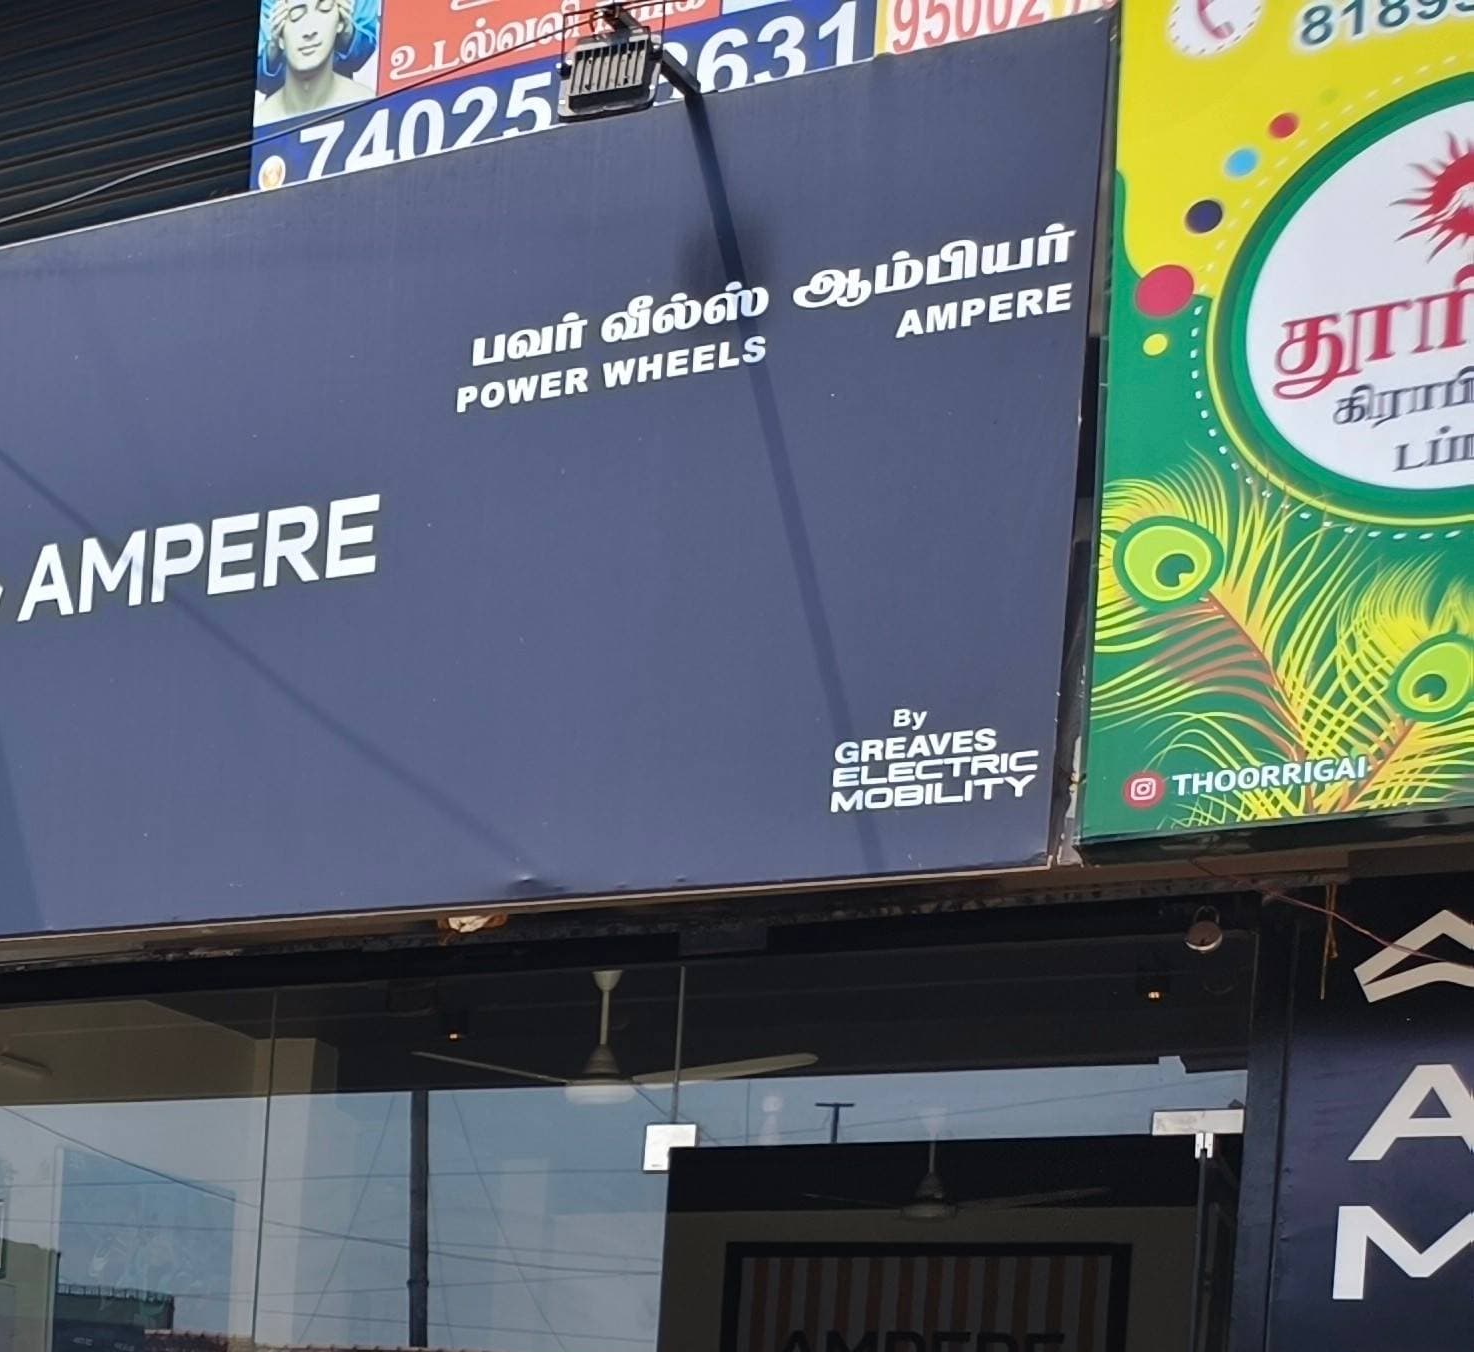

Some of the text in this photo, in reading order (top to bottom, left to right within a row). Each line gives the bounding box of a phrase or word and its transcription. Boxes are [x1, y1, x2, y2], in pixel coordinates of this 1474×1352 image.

[471, 223, 1076, 368] பவர் வீல்ஸ் ஆம்பியர்
[456, 282, 1073, 413] POWER WHEELS AMPERE
[16, 493, 381, 622] AMPERE
[892, 708, 928, 731] By
[834, 727, 997, 765] GREAVES
[832, 749, 1039, 788] ELECTRIC
[1172, 755, 1369, 797] THOORRIGAI
[830, 774, 1037, 813] MOBILITY
